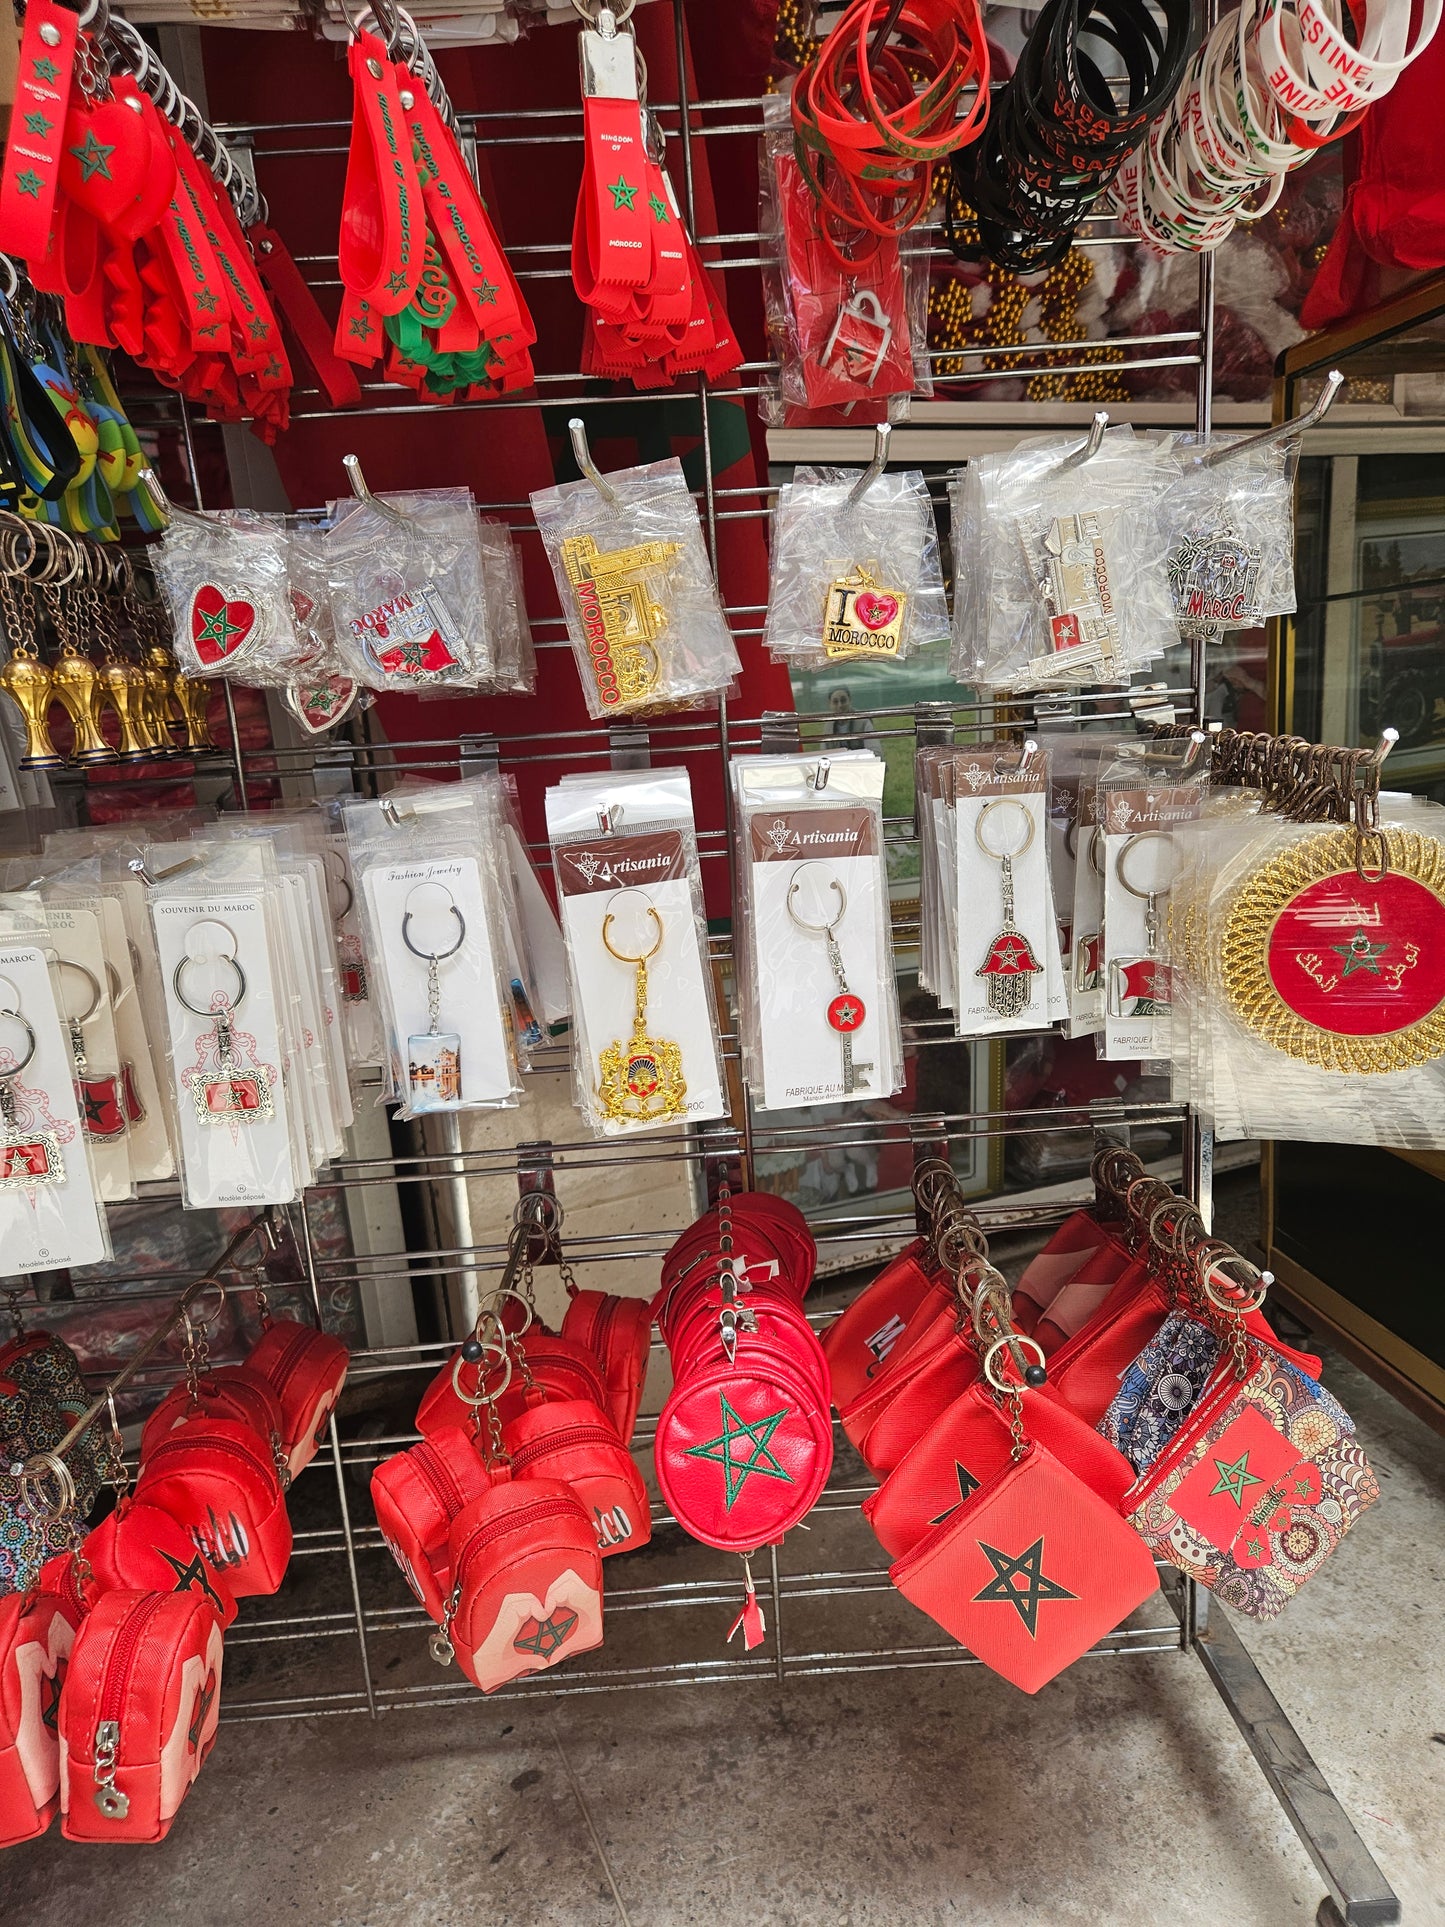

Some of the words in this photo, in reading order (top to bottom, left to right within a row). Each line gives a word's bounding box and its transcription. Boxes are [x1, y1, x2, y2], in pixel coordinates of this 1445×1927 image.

[377, 92, 398, 154] KINGDOM
[601, 133, 633, 144] KINGDOM
[13, 145, 53, 163] MOROCCO
[393, 160, 405, 180] OF
[411, 122, 440, 179] KINGDOM
[437, 181, 452, 199] OF
[446, 203, 483, 274] MOROCCO
[1018, 178, 1076, 210] SAVE
[398, 183, 412, 265] MOROCCO
[174, 215, 206, 283] MOROCCO
[609, 239, 642, 249] MOROCCO
[216, 251, 254, 312] MOROCCO
[1094, 547, 1113, 614] MOROCCO
[349, 591, 415, 637] MAROC
[831, 588, 856, 627] I
[577, 580, 621, 705] MOROCCO
[828, 627, 895, 649] MOROCCO
[984, 773, 1040, 785] Artisania
[1131, 808, 1193, 823] Artisania
[790, 828, 859, 845] Artisania
[600, 852, 672, 876] Artisania
[387, 870, 424, 881] Fashion
[160, 905, 206, 914] SOUVENIR
[207, 905, 222, 914] DU
[224, 903, 257, 913] MAROC
[1339, 897, 1381, 927] الله
[0, 954, 37, 965] MAROC
[1112, 1036, 1149, 1045] FABRIQUE
[785, 1085, 824, 1097] FABRIQUE
[825, 1084, 836, 1093] AU
[218, 1193, 242, 1203] Modèle
[242, 1192, 265, 1202] déposé
[19, 1260, 45, 1270] Modèle
[45, 1256, 72, 1268] déposé
